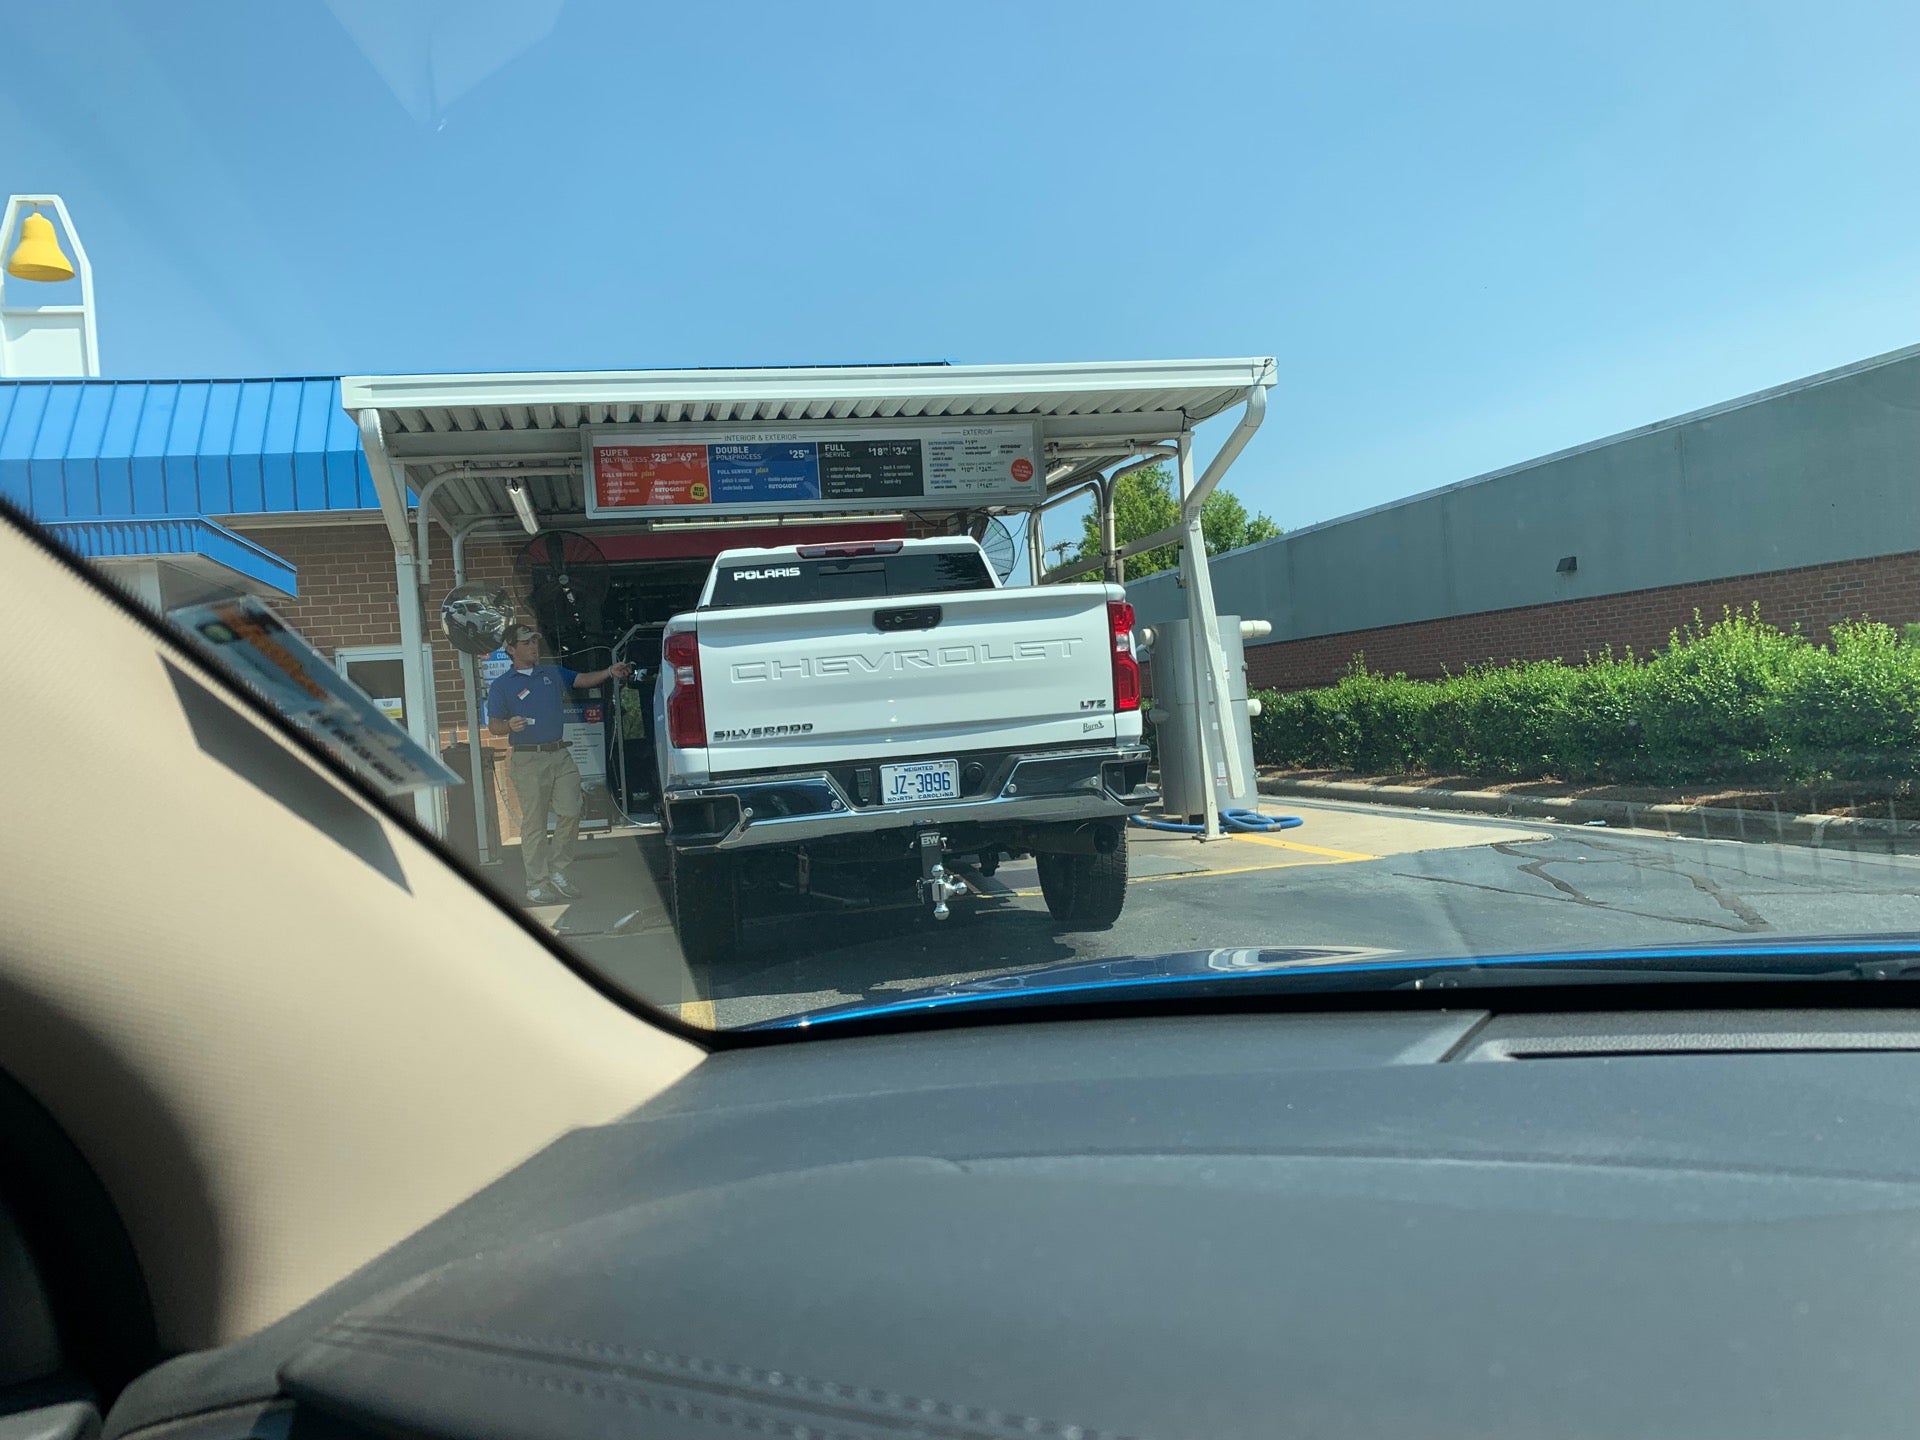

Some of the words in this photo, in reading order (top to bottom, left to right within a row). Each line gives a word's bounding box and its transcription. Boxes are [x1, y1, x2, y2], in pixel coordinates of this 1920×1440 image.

[600, 449, 629, 457] SUPER
[715, 446, 749, 454] DOUBLE
[733, 567, 801, 581] POLARIS
[730, 637, 1083, 684] CHEVROLET
[1080, 699, 1106, 710] LTZ
[713, 723, 813, 740] SILVERADO
[890, 771, 951, 795] JZ-3896
